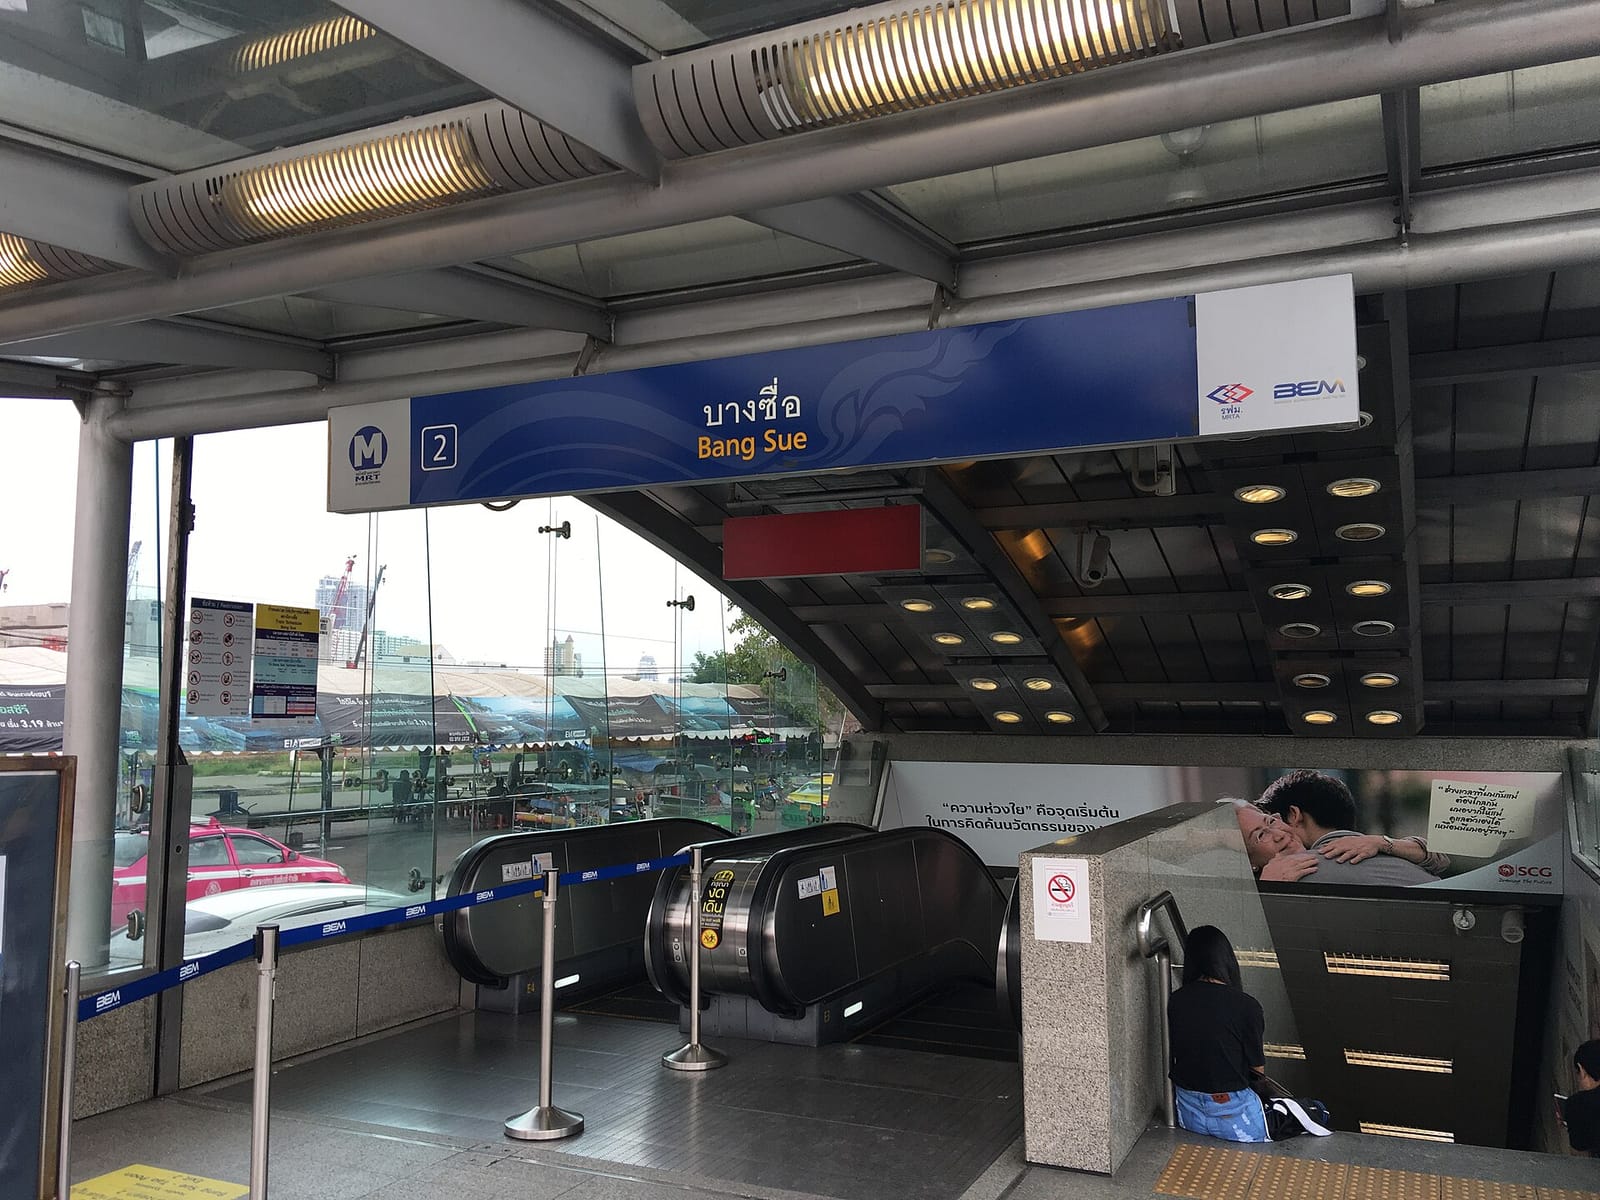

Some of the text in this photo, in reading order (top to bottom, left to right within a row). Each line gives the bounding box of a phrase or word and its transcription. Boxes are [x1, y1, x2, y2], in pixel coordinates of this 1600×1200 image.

[1273, 378, 1346, 399] BEM
[703, 377, 801, 427] บางซื่อ
[433, 434, 446, 461] 2
[698, 429, 808, 461] Bang Sue
[355, 473, 381, 482] MRT
[20, 719, 44, 728] 3.19
[1036, 802, 1120, 820] คือจุดเริ่มต้น
[1518, 866, 1553, 877] SCG
[708, 888, 725, 898] งด
[405, 905, 426, 917] BEM
[703, 899, 723, 913] เดิน
[322, 920, 346, 933] BEM
[180, 961, 199, 977] BEM
[96, 990, 121, 1008] BEM
